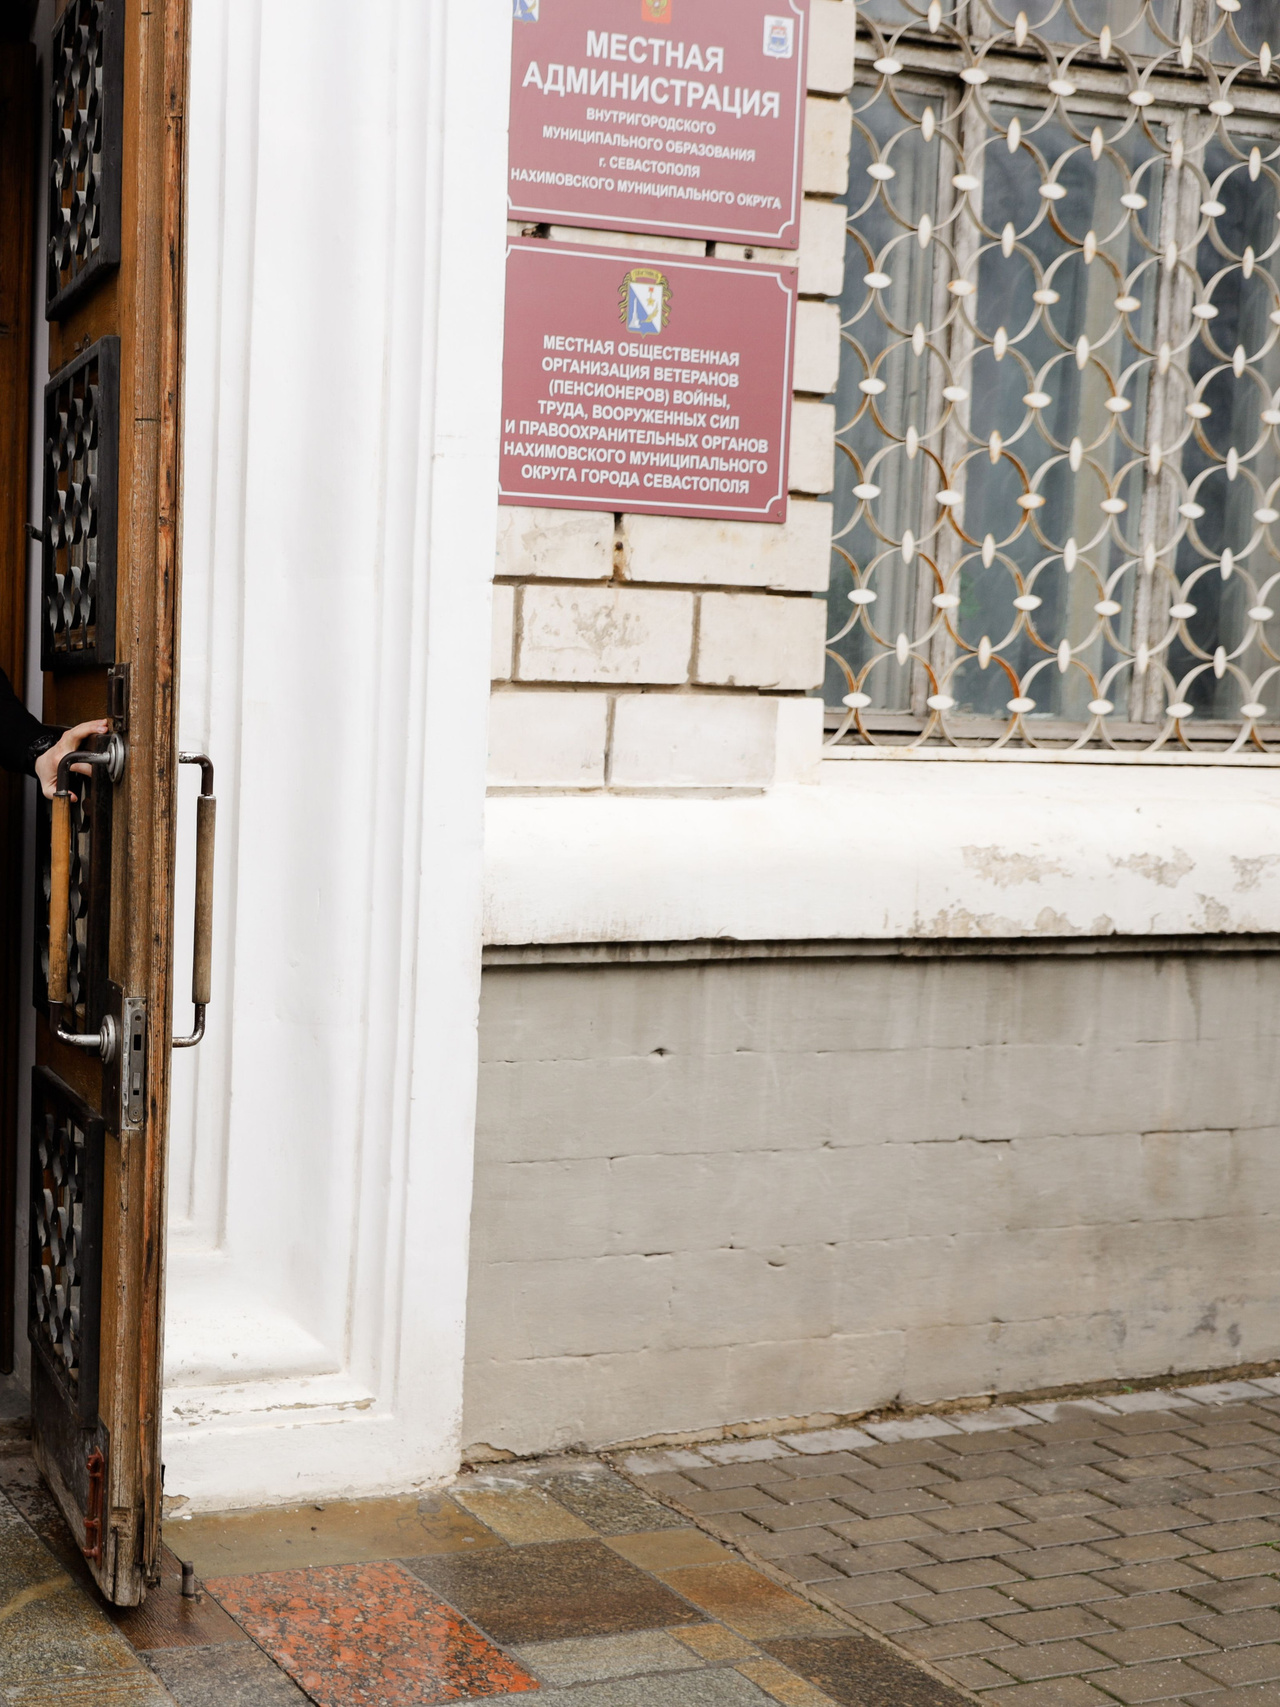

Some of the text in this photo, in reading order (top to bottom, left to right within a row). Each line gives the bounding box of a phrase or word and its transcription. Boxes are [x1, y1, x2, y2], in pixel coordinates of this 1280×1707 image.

[586, 29, 724, 74] МЕСТНАЯ
[522, 61, 780, 119] АДМИНИСТРАЦИЯ
[586, 107, 716, 136] ВНУТРИГОРОДСКОГО
[542, 125, 756, 162] МУНИЦИПАЛЬНОГО ОБРАЗОВАНИЯ
[599, 156, 700, 178] г. СЕВАСТОПОЛЯ
[511, 167, 782, 210] НАХИМОВСКОГО МУНИЦИПАЛЬНОГО ОКРУГА
[543, 335, 740, 366] МЕСТНАЯ ОБЩЕСТВЕННАЯ
[541, 356, 739, 388] ОРГАНИЗАЦИЯ ВЕТЕРАНОВ
[549, 379, 731, 410] (ПЕНСИОНЕРОВ) ВОЙНЫ,
[538, 400, 740, 430] ТРУДА, ВООРУЖЕННЫХ СИЛ
[505, 420, 769, 453] И ПРАВООХРАНИТЕЛЬНЫХ ОРГАНОВ
[503, 441, 768, 474] НАХИМОВСКОГО МУНИЦИПАЛЬНОГО
[521, 464, 749, 494] ОКРУГА ГОРОДА СЕВАСТОПОЛЯ
